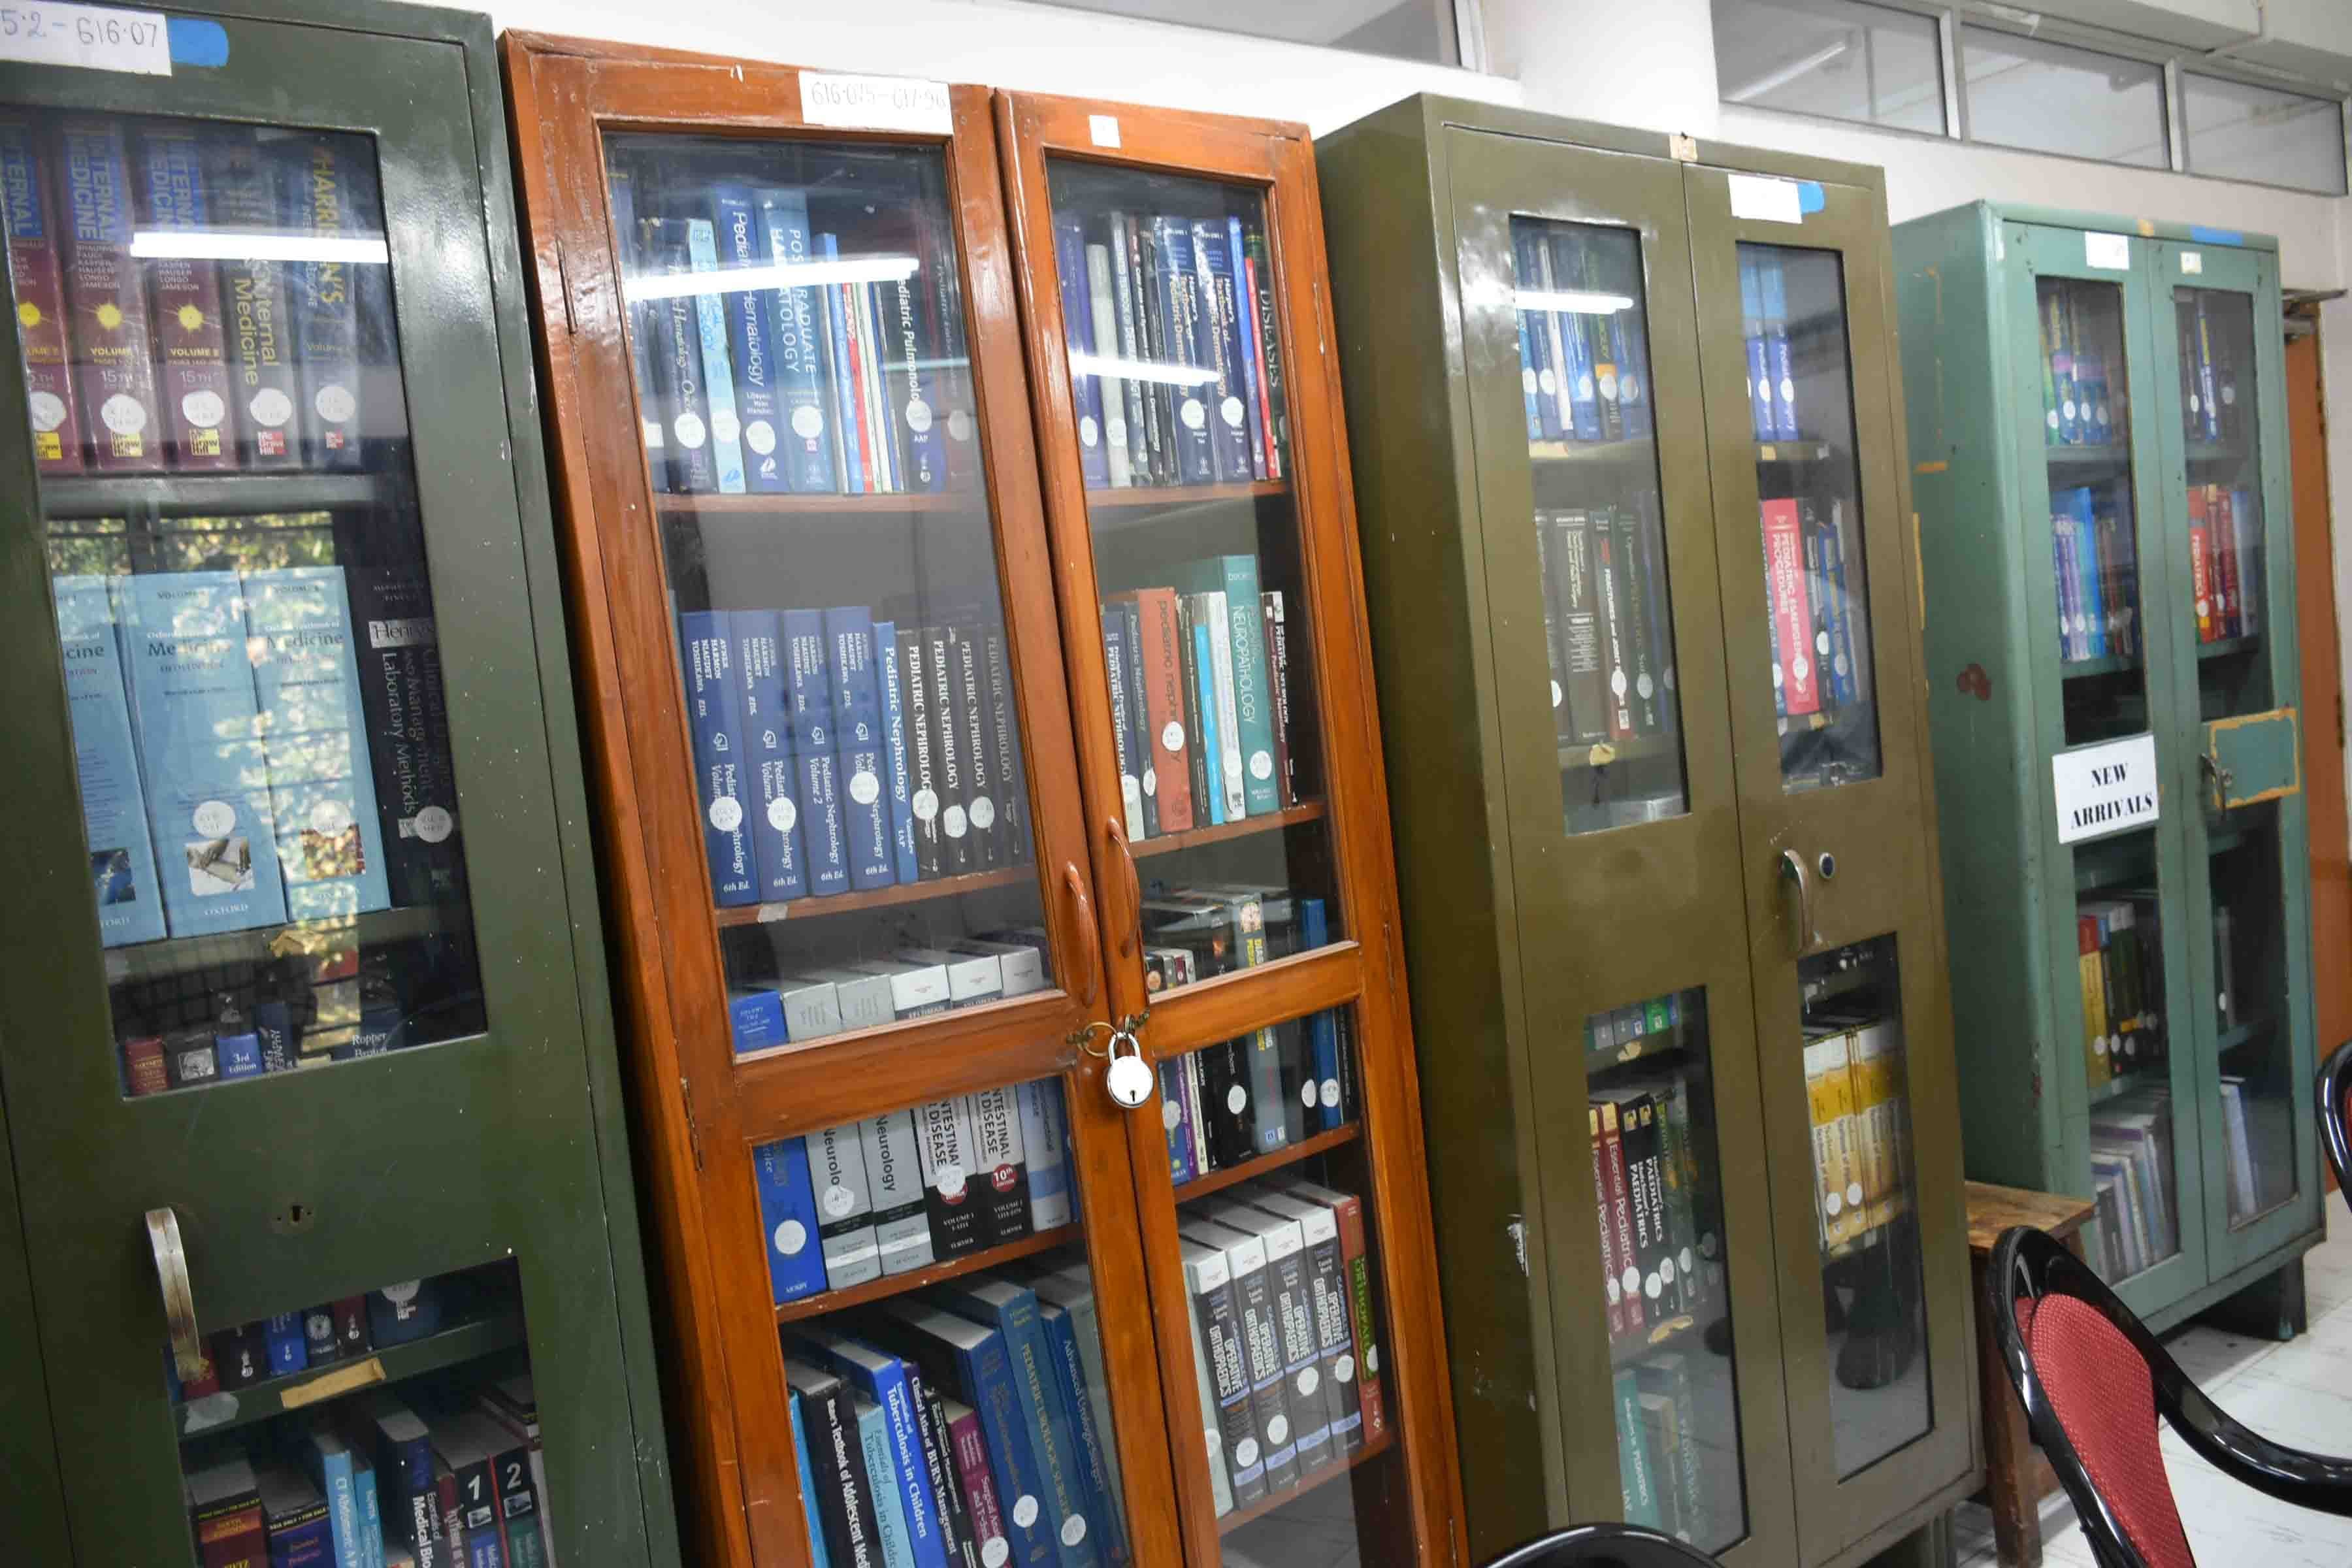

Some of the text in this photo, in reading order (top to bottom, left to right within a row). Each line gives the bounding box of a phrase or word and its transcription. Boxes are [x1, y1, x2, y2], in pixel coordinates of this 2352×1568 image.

[732, 210, 753, 268] Pediatr
[789, 229, 817, 373] POSRADUATE
[1215, 276, 1226, 330] Textbook
[1224, 277, 1234, 323] Harper's
[170, 348, 208, 357] VOLUME
[233, 277, 261, 387] Medicine
[897, 273, 921, 396] ediatric Pulmonolo
[1260, 289, 1282, 388] DISEASES
[65, 644, 105, 659] cine
[267, 628, 344, 649] Medicine
[1233, 606, 1256, 724] NEUROPATHOLOGY
[987, 636, 1005, 704] PEDIATRIC
[1107, 646, 1119, 701] PEDIATRIC
[1130, 615, 1147, 732] Pediatric Nephrology
[383, 653, 420, 815] Laboratory Methods
[885, 647, 907, 803] Pediatric Nephrology
[909, 645, 932, 790] PEDIATRIC NEPHROLOG
[933, 640, 959, 790] PEDIATRIC NEPHROLOGY
[960, 640, 986, 788] PEDIATRIC NEPHROLOGY
[994, 704, 1014, 781] NEPHROLOGY
[711, 765, 723, 799] Volum
[760, 761, 773, 801] Volume
[809, 757, 822, 796] Volume
[2091, 762, 2129, 787] NEW
[725, 763, 745, 875] Pediat phrology
[821, 757, 840, 865] Pediatric Nephrology
[2070, 794, 2153, 830] ARRIVALS
[723, 880, 751, 893] 6th Ed.
[773, 875, 799, 888] 6th Ed.
[821, 869, 845, 881] 6th Ed.
[865, 864, 889, 875] 6th Ed.
[204, 903, 250, 916] OXFORD
[233, 1053, 250, 1063] 3rd
[352, 1032, 387, 1045] Ropper
[229, 1063, 257, 1073] Edition
[876, 1114, 896, 1192] Neurology
[928, 1110, 947, 1167] DISEASE
[940, 1100, 961, 1166] NTESTINA
[981, 1098, 999, 1154] DISEASE
[823, 1128, 842, 1186] Neurolo
[992, 1168, 1015, 1182] 10th
[996, 1178, 1015, 1187] EDITION
[943, 1213, 970, 1226] VOLUME
[994, 1200, 1019, 1214] VOLUME
[1609, 1143, 1633, 1269] Essential Pediatric
[1629, 1164, 1649, 1249] PAEDIATRICS
[1645, 1158, 1663, 1243] PAEDIATRICS
[1597, 1203, 1614, 1278] Pediatric
[1279, 1291, 1301, 1363] ORTHOPAEDICS
[1294, 1305, 1311, 1360] OPERATIVE
[1313, 1277, 1334, 1348] ORTHOPAEDICS
[1328, 1291, 1344, 1344] OPERATIVE
[1209, 1324, 1233, 1398] ORTHOPAEDICS
[1224, 1337, 1241, 1392] OPERATIVE
[1244, 1307, 1267, 1381] ORTHOPAEDICS
[1259, 1322, 1276, 1376] OPERATIVE
[506, 1462, 523, 1490] 2
[832, 1426, 849, 1471] Textbook
[840, 1471, 852, 1481] of
[887, 1386, 926, 1538] Tuberculosis in Children
[912, 1376, 957, 1555] Clinical Atlas of BURN Management
[468, 1474, 481, 1501] 1
[865, 1432, 885, 1522] Tuberculosis in
[413, 1495, 432, 1547] Medical
[842, 1482, 863, 1543] Adolescent
